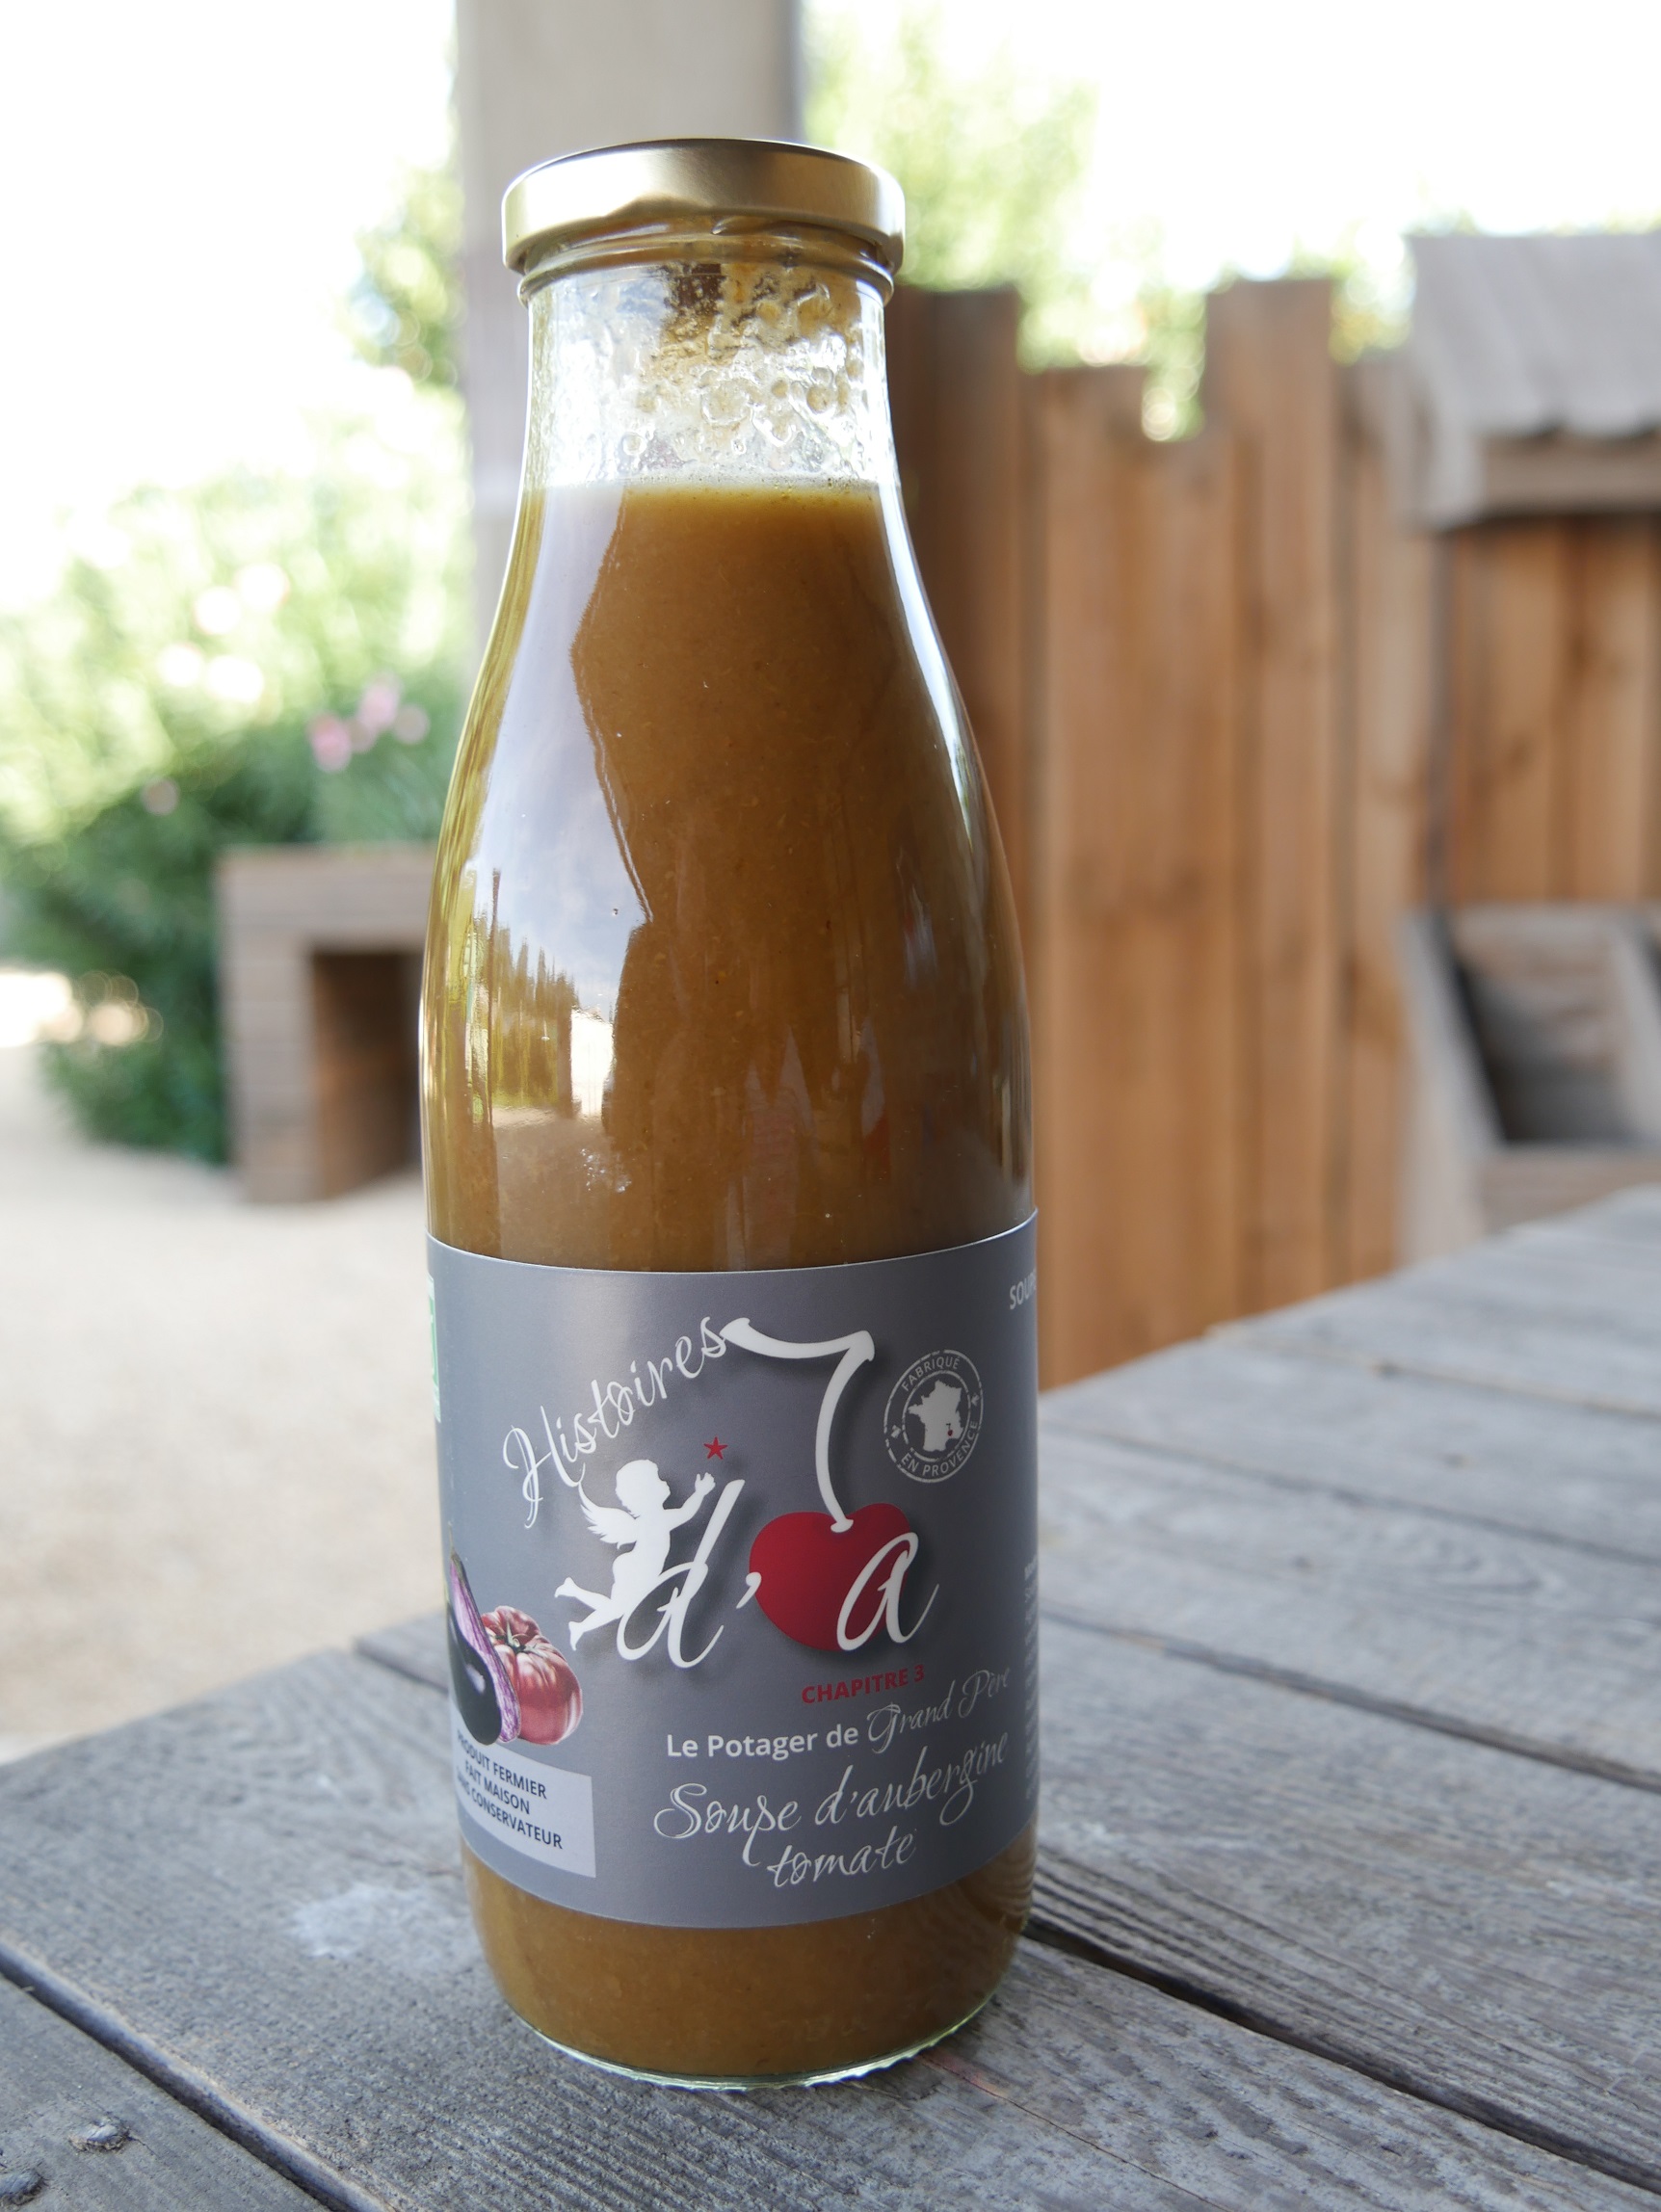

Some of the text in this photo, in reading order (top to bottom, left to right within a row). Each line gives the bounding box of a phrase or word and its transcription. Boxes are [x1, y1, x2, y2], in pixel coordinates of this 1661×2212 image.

[901, 1356, 960, 1392] FABRIQUÉ
[502, 1316, 727, 1529] Histoires
[901, 1420, 979, 1477] EN PROVENCE
[802, 1664, 925, 1705] CHAPITRE 3
[667, 1668, 1010, 1761] Le Potager de Grand Père
[464, 1761, 530, 1814] FAIT MAISON
[493, 1763, 547, 1799] FERMIER
[653, 1732, 1009, 1866] Soupe d'aubergine
[471, 1788, 563, 1849] CONSERVATEUR
[767, 1826, 916, 1887] tomate
